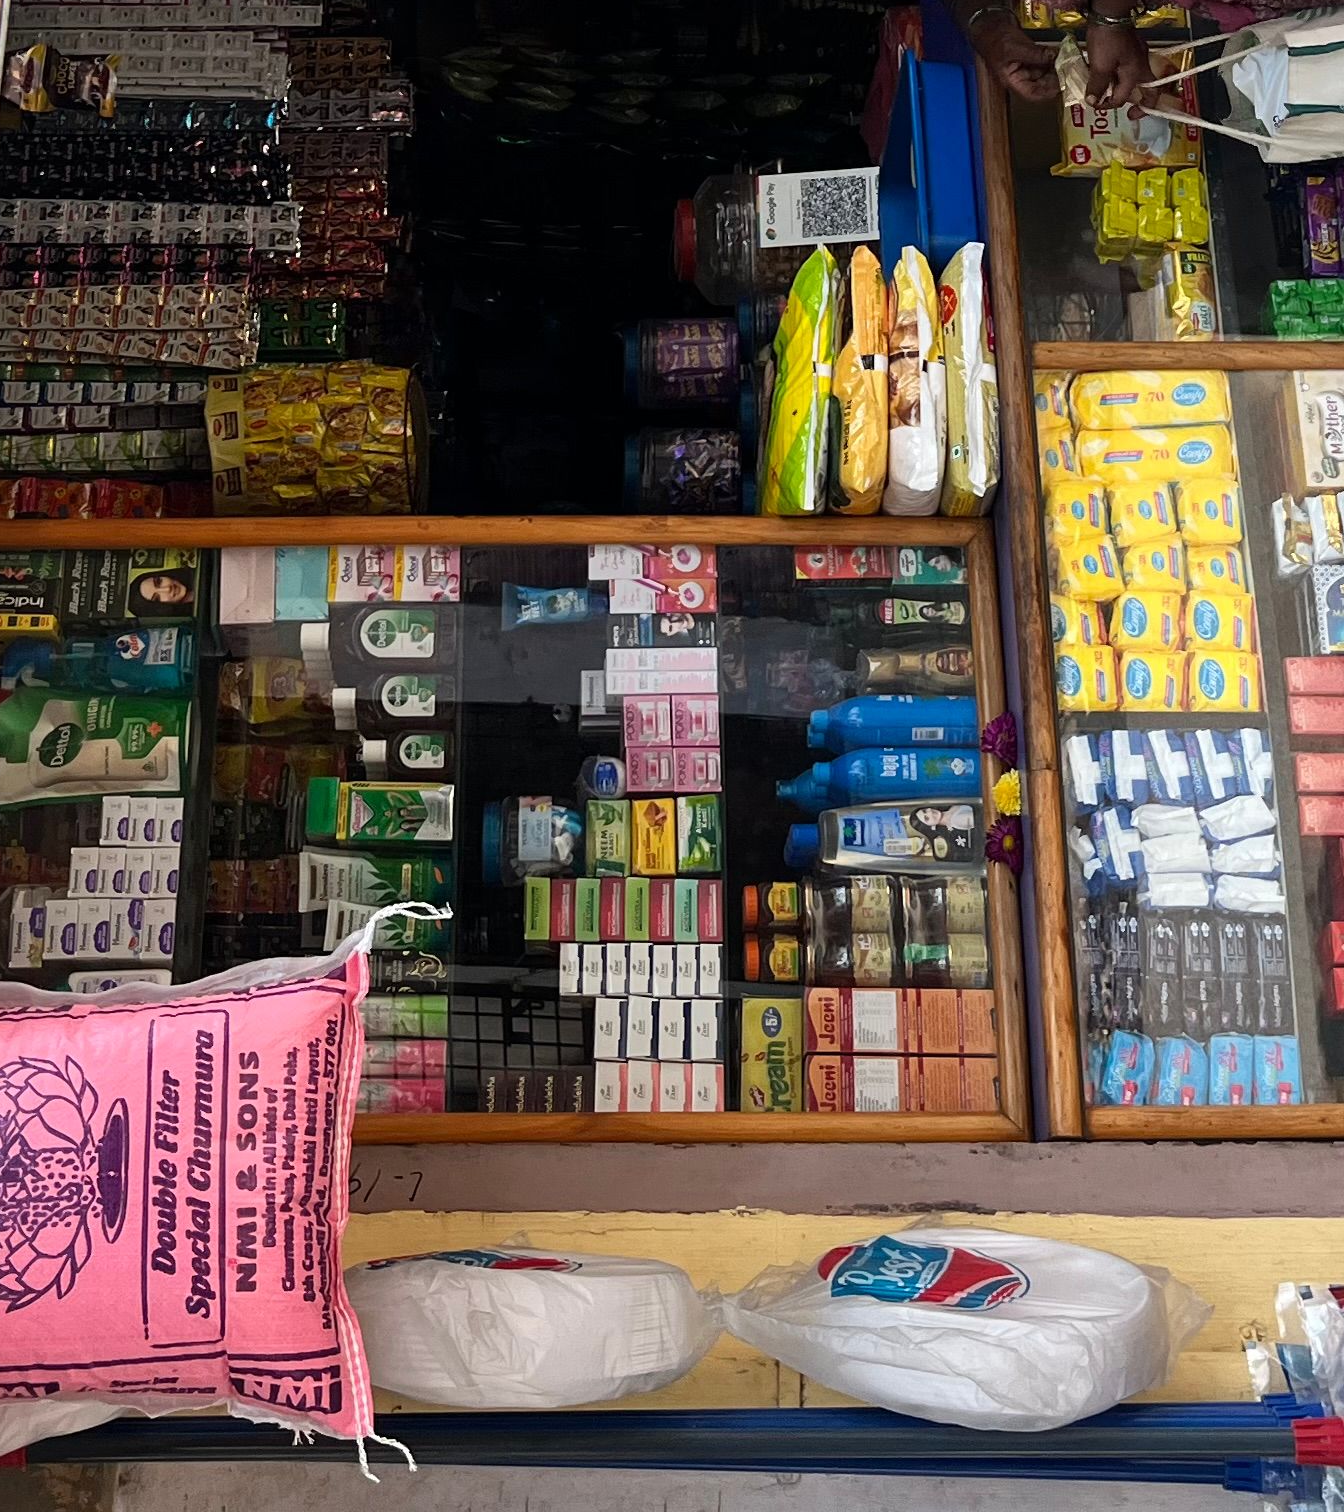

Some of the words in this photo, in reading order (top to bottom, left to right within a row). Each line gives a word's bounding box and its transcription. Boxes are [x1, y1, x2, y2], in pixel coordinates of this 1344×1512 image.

[56, 58, 70, 94] CHOCO
[766, 182, 776, 195] Pay
[766, 197, 777, 225] Google
[341, 556, 353, 583] Odonil
[377, 619, 388, 647] Dettol
[1126, 600, 1143, 636] Comfy
[1198, 602, 1214, 638] Comfy
[1130, 660, 1145, 696] Comfy
[1203, 661, 1219, 698] Comfy
[626, 704, 636, 741] POND'S
[675, 701, 684, 740] POND'S
[50, 725, 71, 765] Dettol
[630, 753, 639, 786] POND'S
[677, 753, 686, 786] POND'S
[880, 755, 899, 777] bajaj
[600, 830, 608, 859] NEEM
[818, 996, 836, 1044] Jeeni
[154, 1070, 180, 1153] Filter
[188, 1031, 213, 1191] Churmura
[237, 1051, 258, 1150] SONS
[237, 1164, 257, 1190] &
[152, 1159, 178, 1275] Double
[186, 1197, 216, 1318] Special
[236, 1208, 257, 1292] NMI
